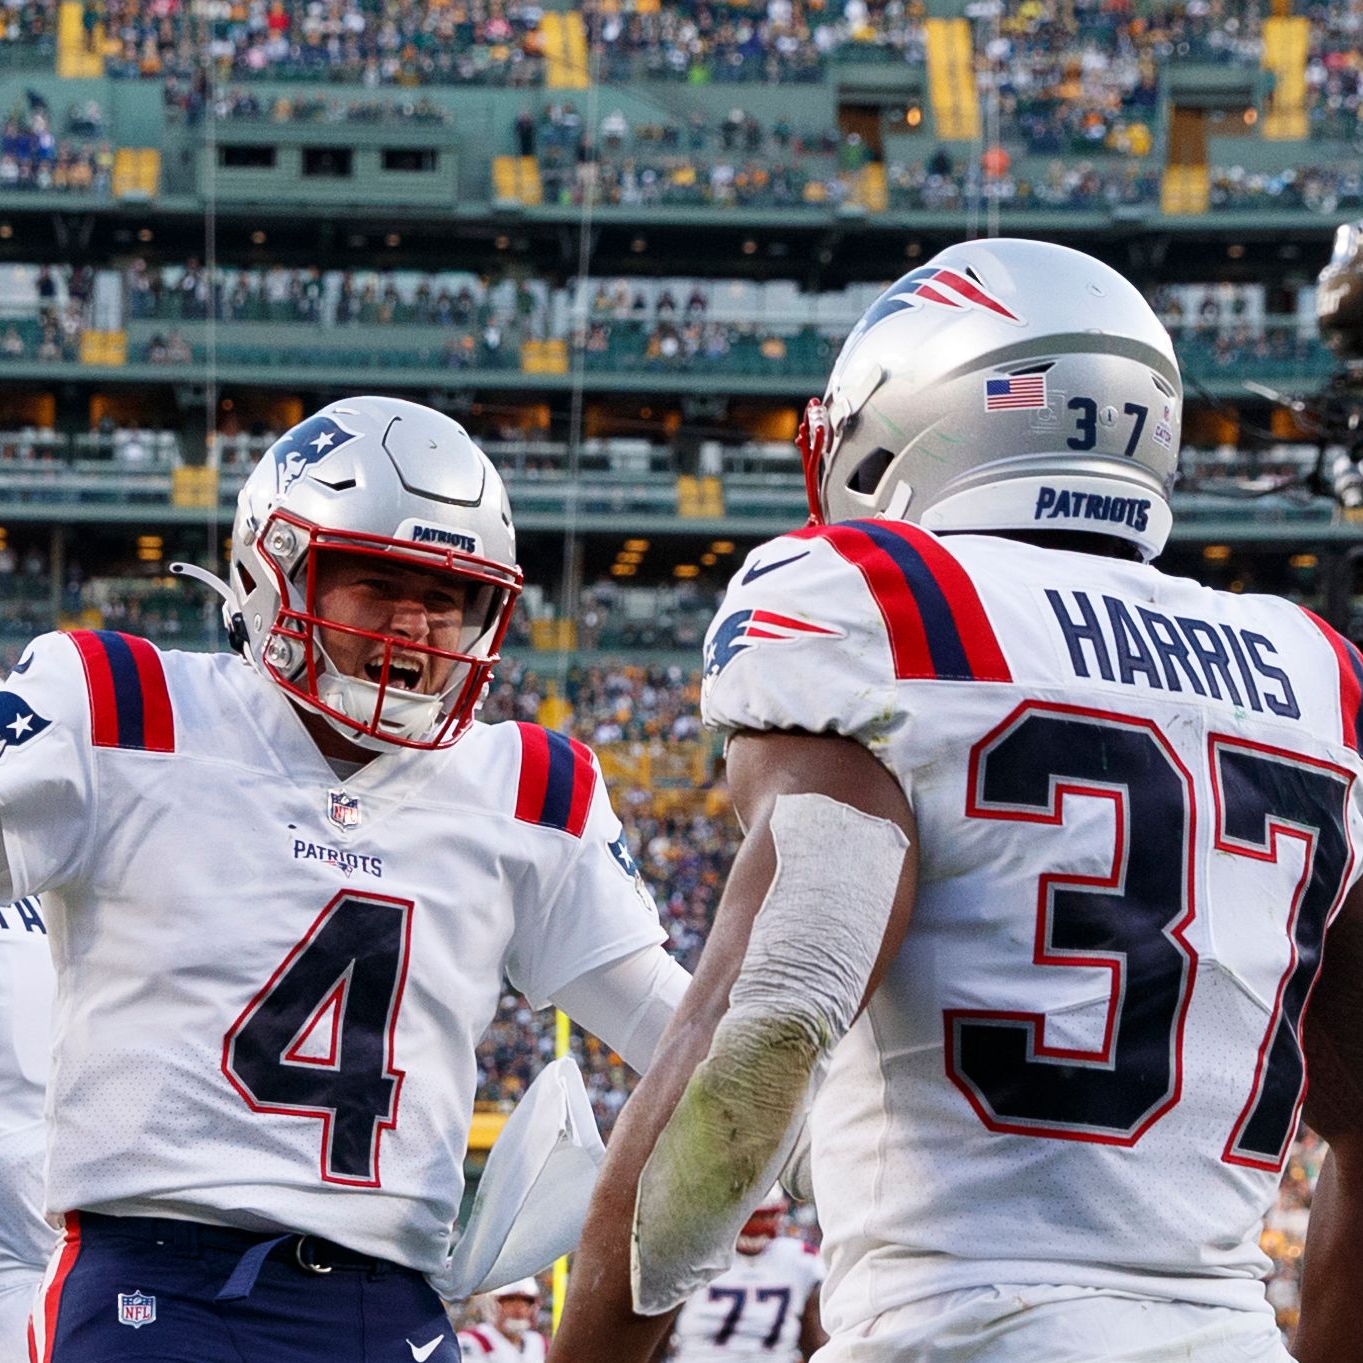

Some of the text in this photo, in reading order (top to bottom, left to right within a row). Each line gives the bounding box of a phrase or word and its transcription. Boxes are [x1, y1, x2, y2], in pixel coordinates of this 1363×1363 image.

[1034, 486, 1151, 532] PATRIOTS
[412, 525, 476, 553] PATRIOTS
[1043, 588, 1302, 722] HARRIS
[334, 804, 358, 825] NFL
[293, 839, 383, 878] PATRIOTS
[944, 699, 1358, 1172] 37
[221, 888, 415, 1188] 4
[125, 1306, 150, 1320] NFL
[709, 1286, 790, 1350] 77
